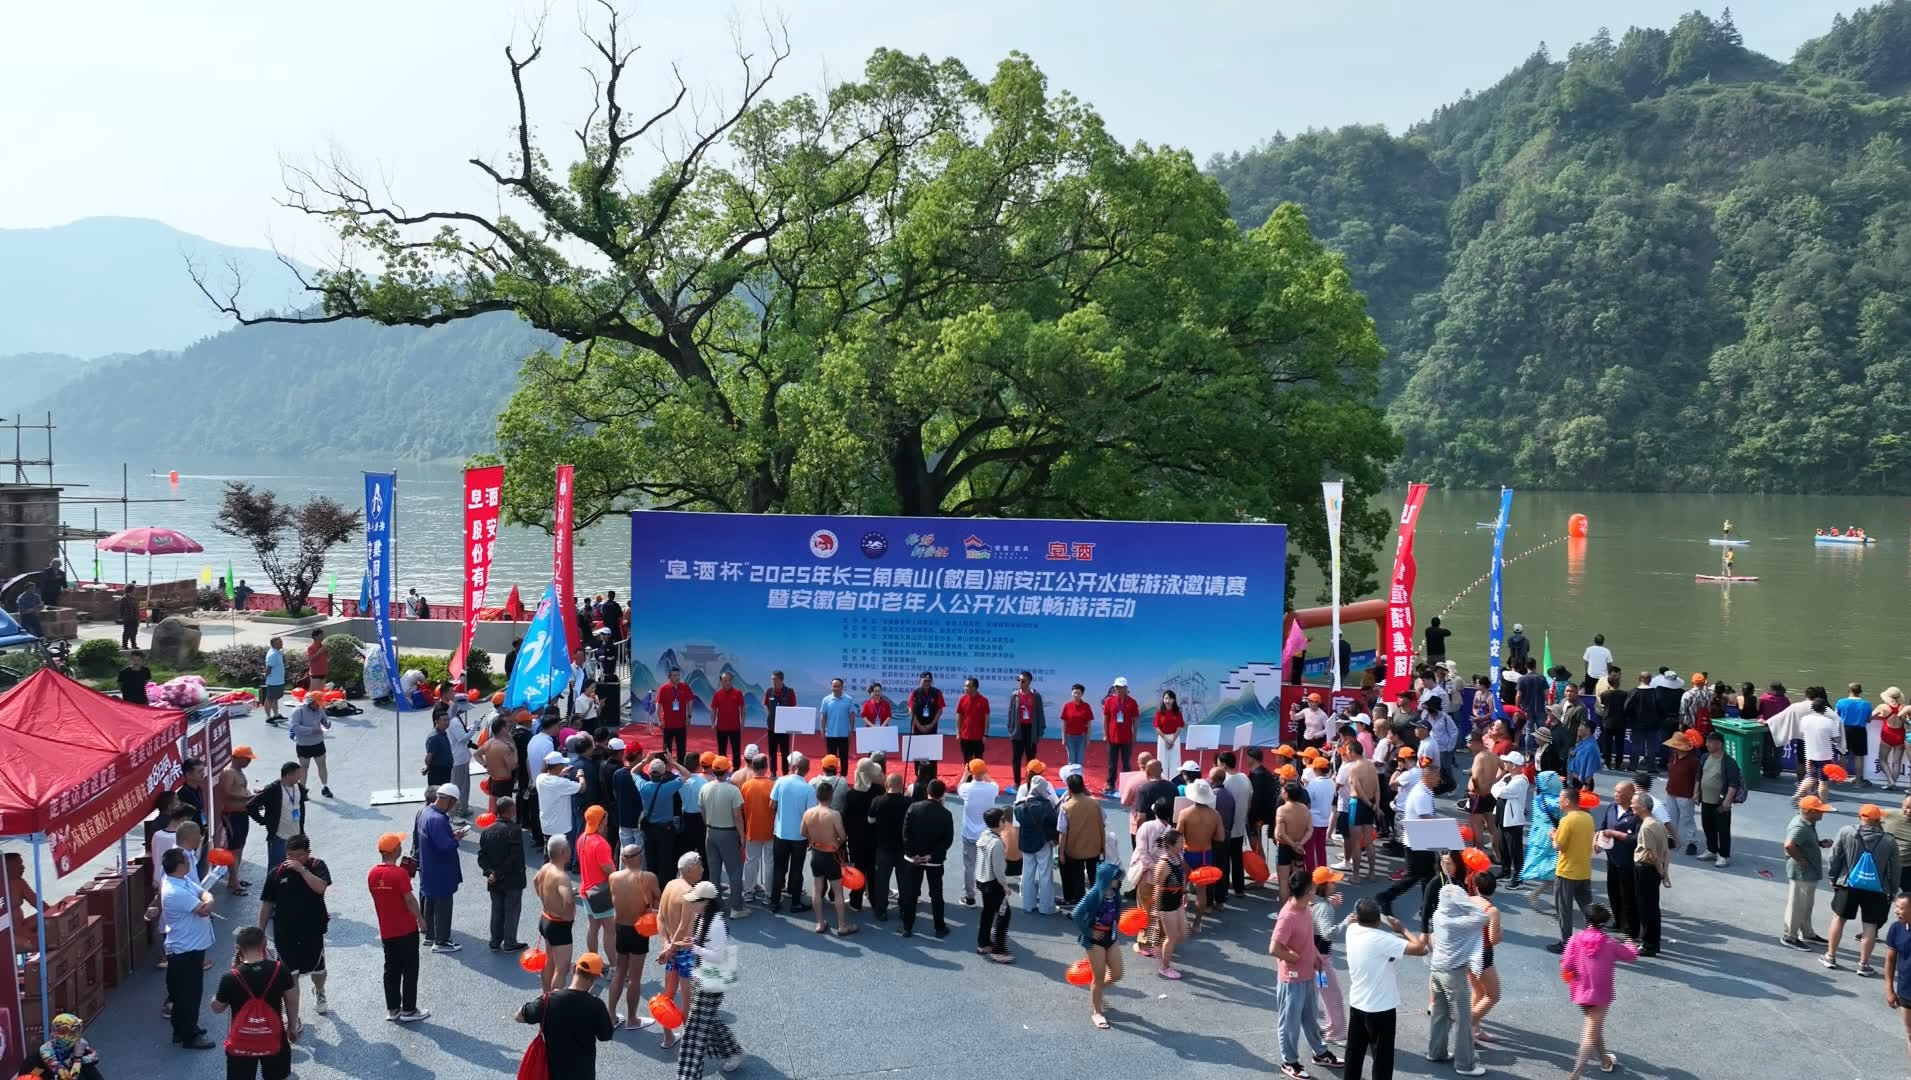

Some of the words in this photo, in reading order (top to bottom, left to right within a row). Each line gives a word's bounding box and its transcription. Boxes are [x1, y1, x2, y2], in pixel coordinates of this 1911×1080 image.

[1045, 540, 1096, 561] 宣酒
[766, 588, 1136, 618] 暨安徽省中老年人公开水域畅游活动
